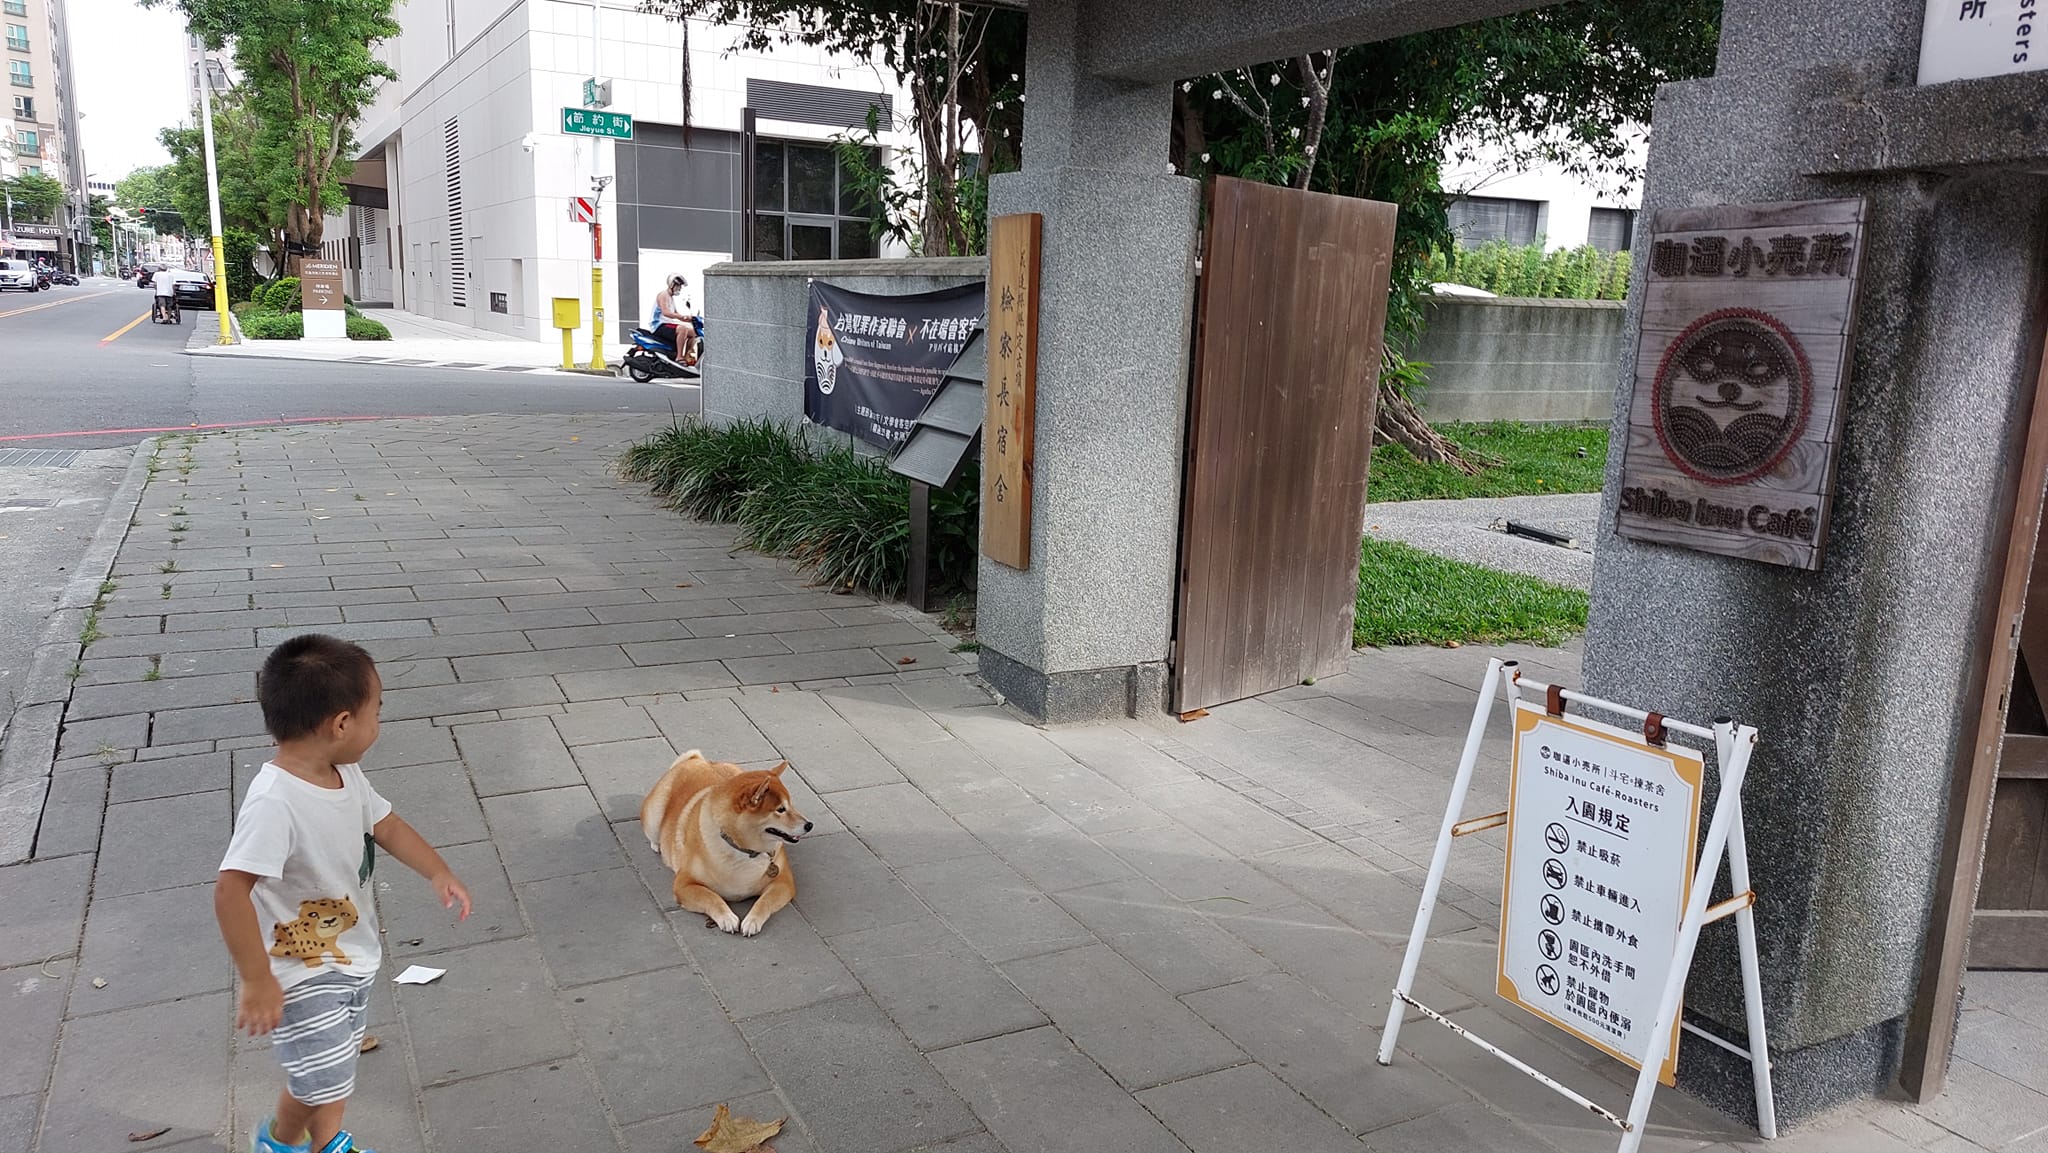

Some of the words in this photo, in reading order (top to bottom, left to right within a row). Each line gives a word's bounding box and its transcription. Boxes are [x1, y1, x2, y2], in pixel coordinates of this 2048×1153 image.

[573, 112, 624, 128] 節約街
[580, 124, 604, 134] Jieyue
[834, 312, 907, 340] 台灣犯罪作家聯會
[1620, 485, 1692, 523] Shiba
[1694, 496, 1745, 530] Inu
[1748, 502, 1817, 540] Café
[1544, 766, 1569, 782] Shiba
[1572, 776, 1587, 788] Inu
[1590, 782, 1660, 812] Café-Roasters
[1565, 796, 1631, 834] 入園規定
[1576, 839, 1622, 868] 禁止吸菸
[1574, 874, 1641, 914] 禁止車輛進入
[1570, 908, 1640, 949] 禁止攜帶外食
[1568, 953, 1612, 984] 恕不外借
[1569, 938, 1636, 980] 園區內洗手間
[1566, 975, 1610, 1006] 禁止寵物
